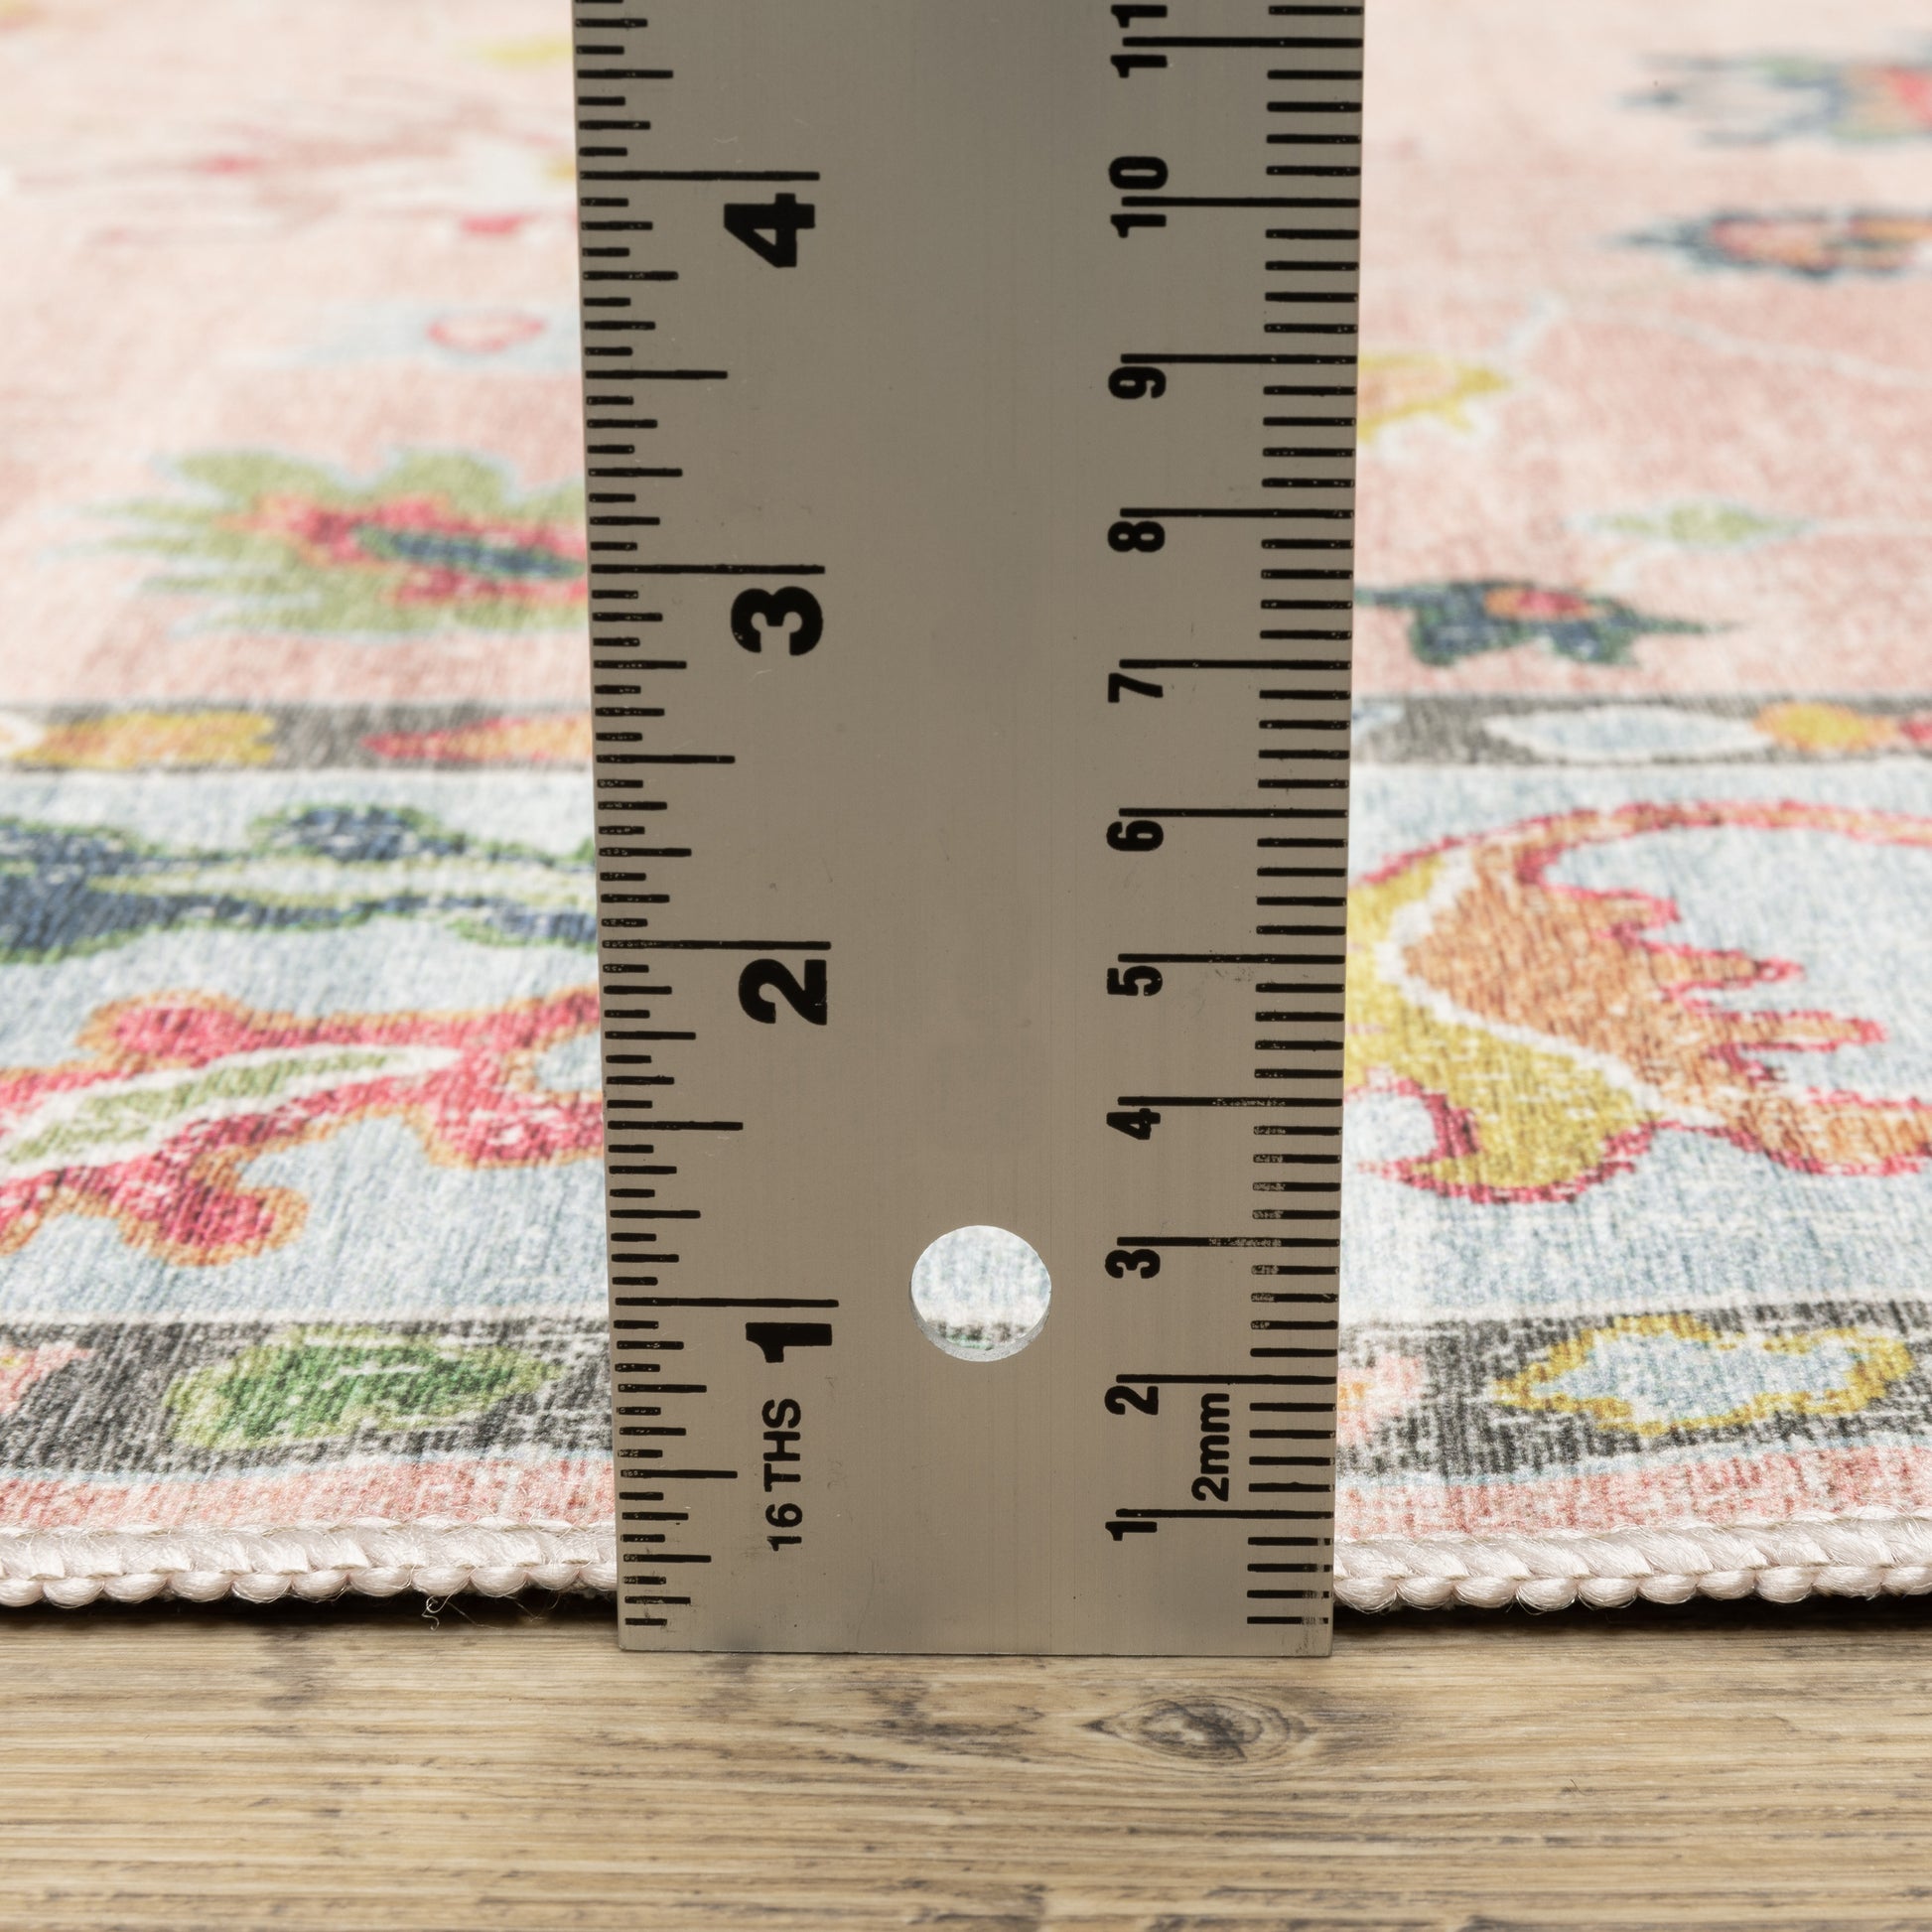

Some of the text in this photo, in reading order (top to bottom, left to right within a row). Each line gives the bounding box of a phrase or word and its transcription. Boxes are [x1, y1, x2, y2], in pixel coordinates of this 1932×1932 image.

[1108, 155, 1169, 239] 10
[723, 192, 816, 269] 4
[1107, 365, 1167, 400] 9
[1107, 520, 1166, 553] 8
[730, 586, 824, 656] 3
[1107, 672, 1164, 704] 7
[1105, 819, 1165, 852] 6
[738, 958, 828, 1027] 2
[1106, 965, 1164, 997] 5
[1106, 1107, 1162, 1141] 4
[1104, 1248, 1161, 1280] 3
[745, 1321, 833, 1364] 1
[1104, 1385, 1160, 1416] 2
[1190, 1392, 1230, 1502] 2mm
[1104, 1520, 1158, 1542] 1
